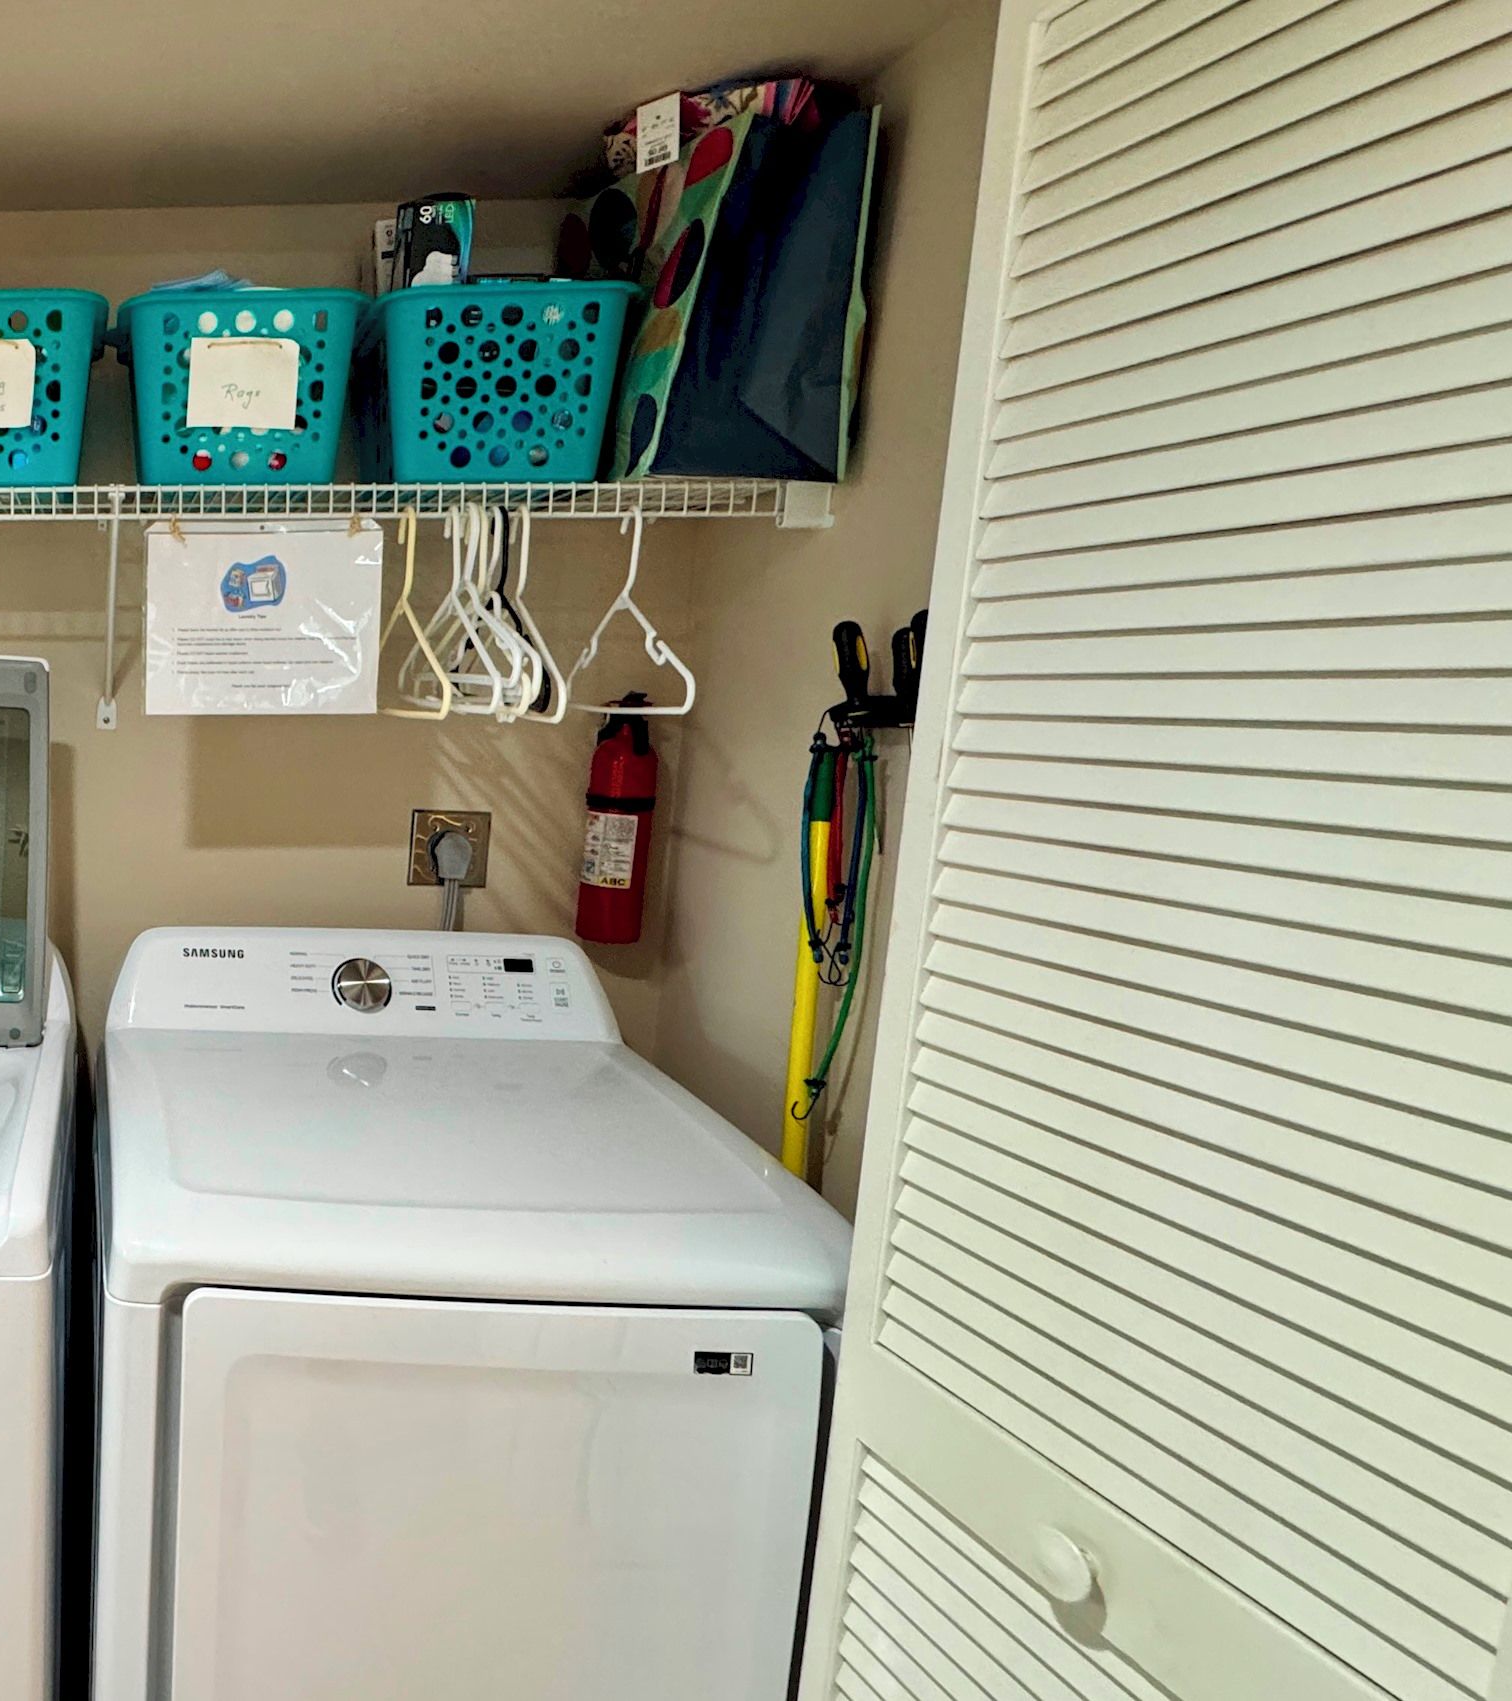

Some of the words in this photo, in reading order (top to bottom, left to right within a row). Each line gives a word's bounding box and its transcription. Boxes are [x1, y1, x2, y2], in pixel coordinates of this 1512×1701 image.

[419, 205, 433, 224] 60
[444, 203, 455, 223] LED
[221, 383, 261, 410] Rags
[600, 877, 626, 886] ABC
[182, 947, 245, 959] SAMSUNG
